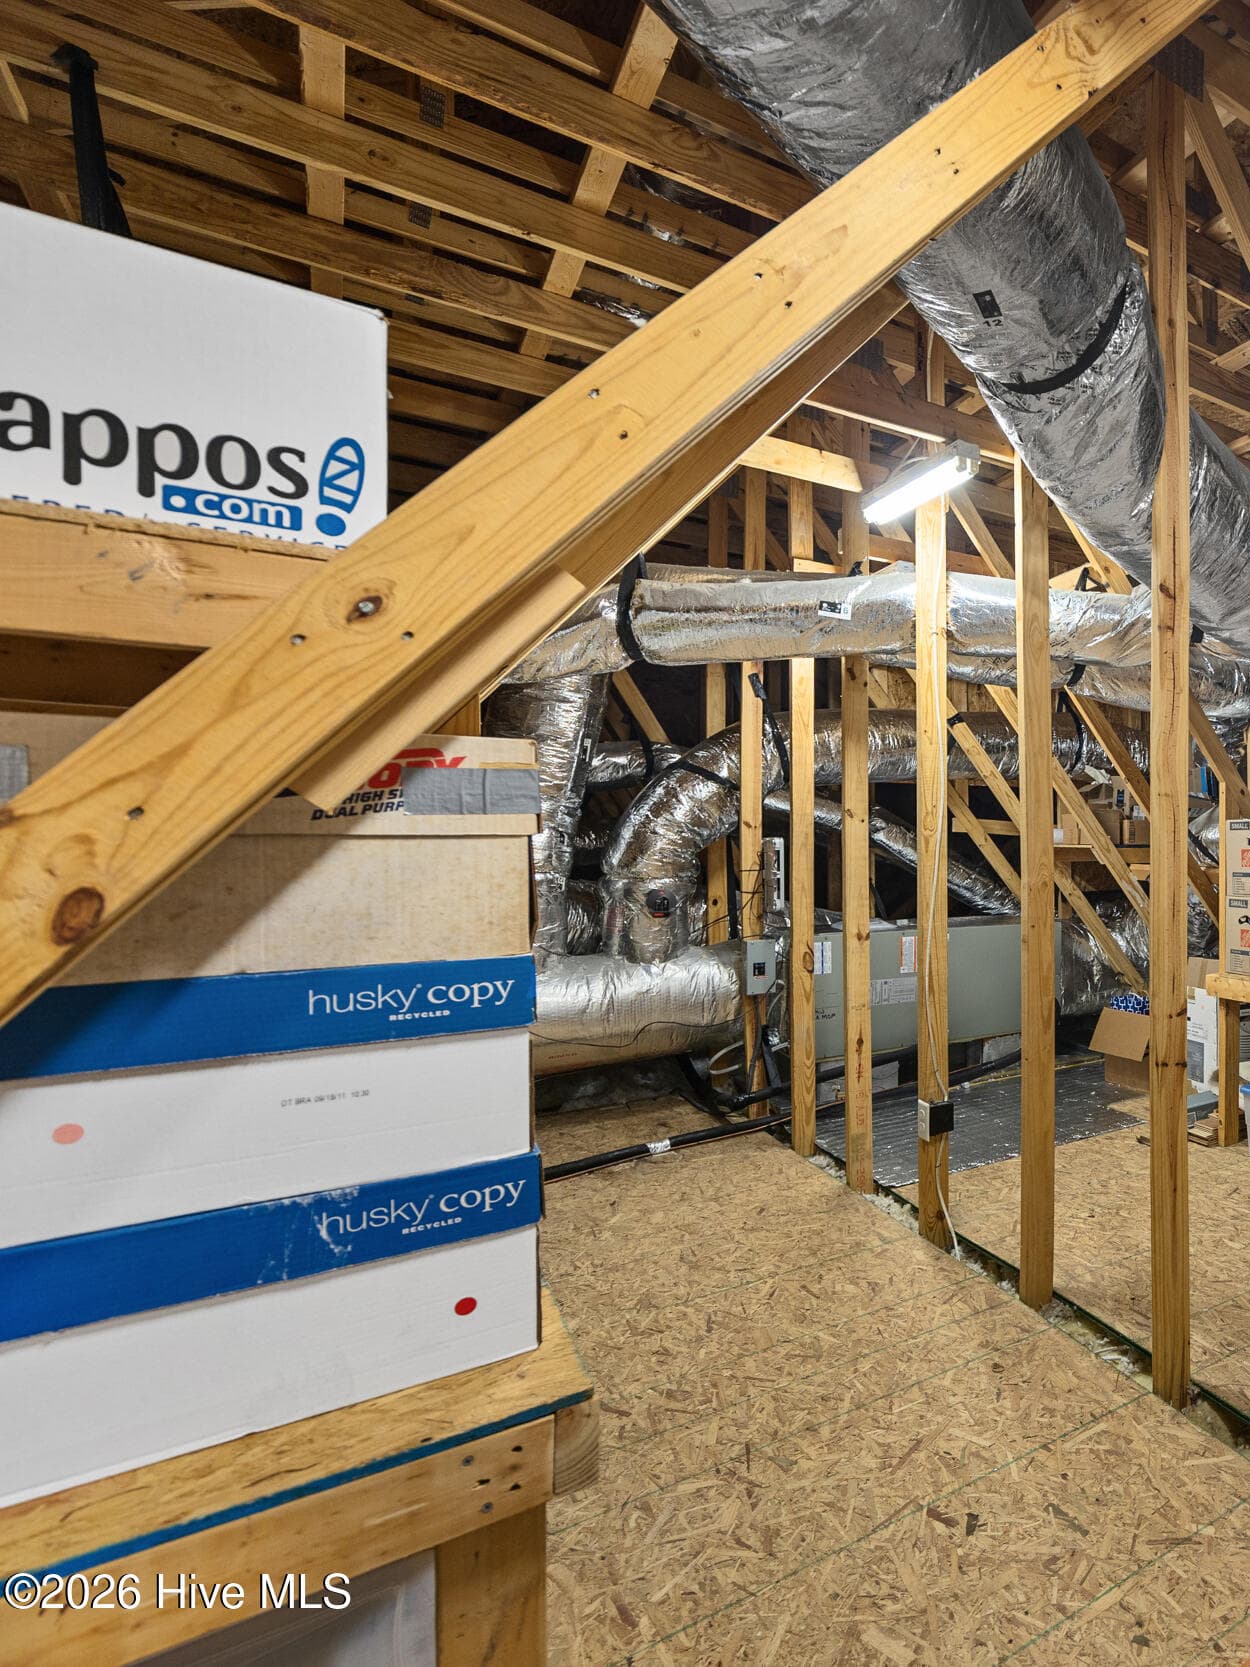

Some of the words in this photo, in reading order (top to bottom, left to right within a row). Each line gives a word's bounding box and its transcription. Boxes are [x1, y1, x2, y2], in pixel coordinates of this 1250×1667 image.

[982, 319, 1003, 328] 12
[0, 391, 309, 500] appos
[168, 493, 292, 529] .com
[308, 983, 418, 1016] husky
[427, 979, 515, 1008] copy
[389, 1009, 451, 1021] RECYCLED
[322, 1197, 431, 1235] husky
[439, 1179, 527, 1213] copy
[402, 1216, 463, 1235] RECYCLED
